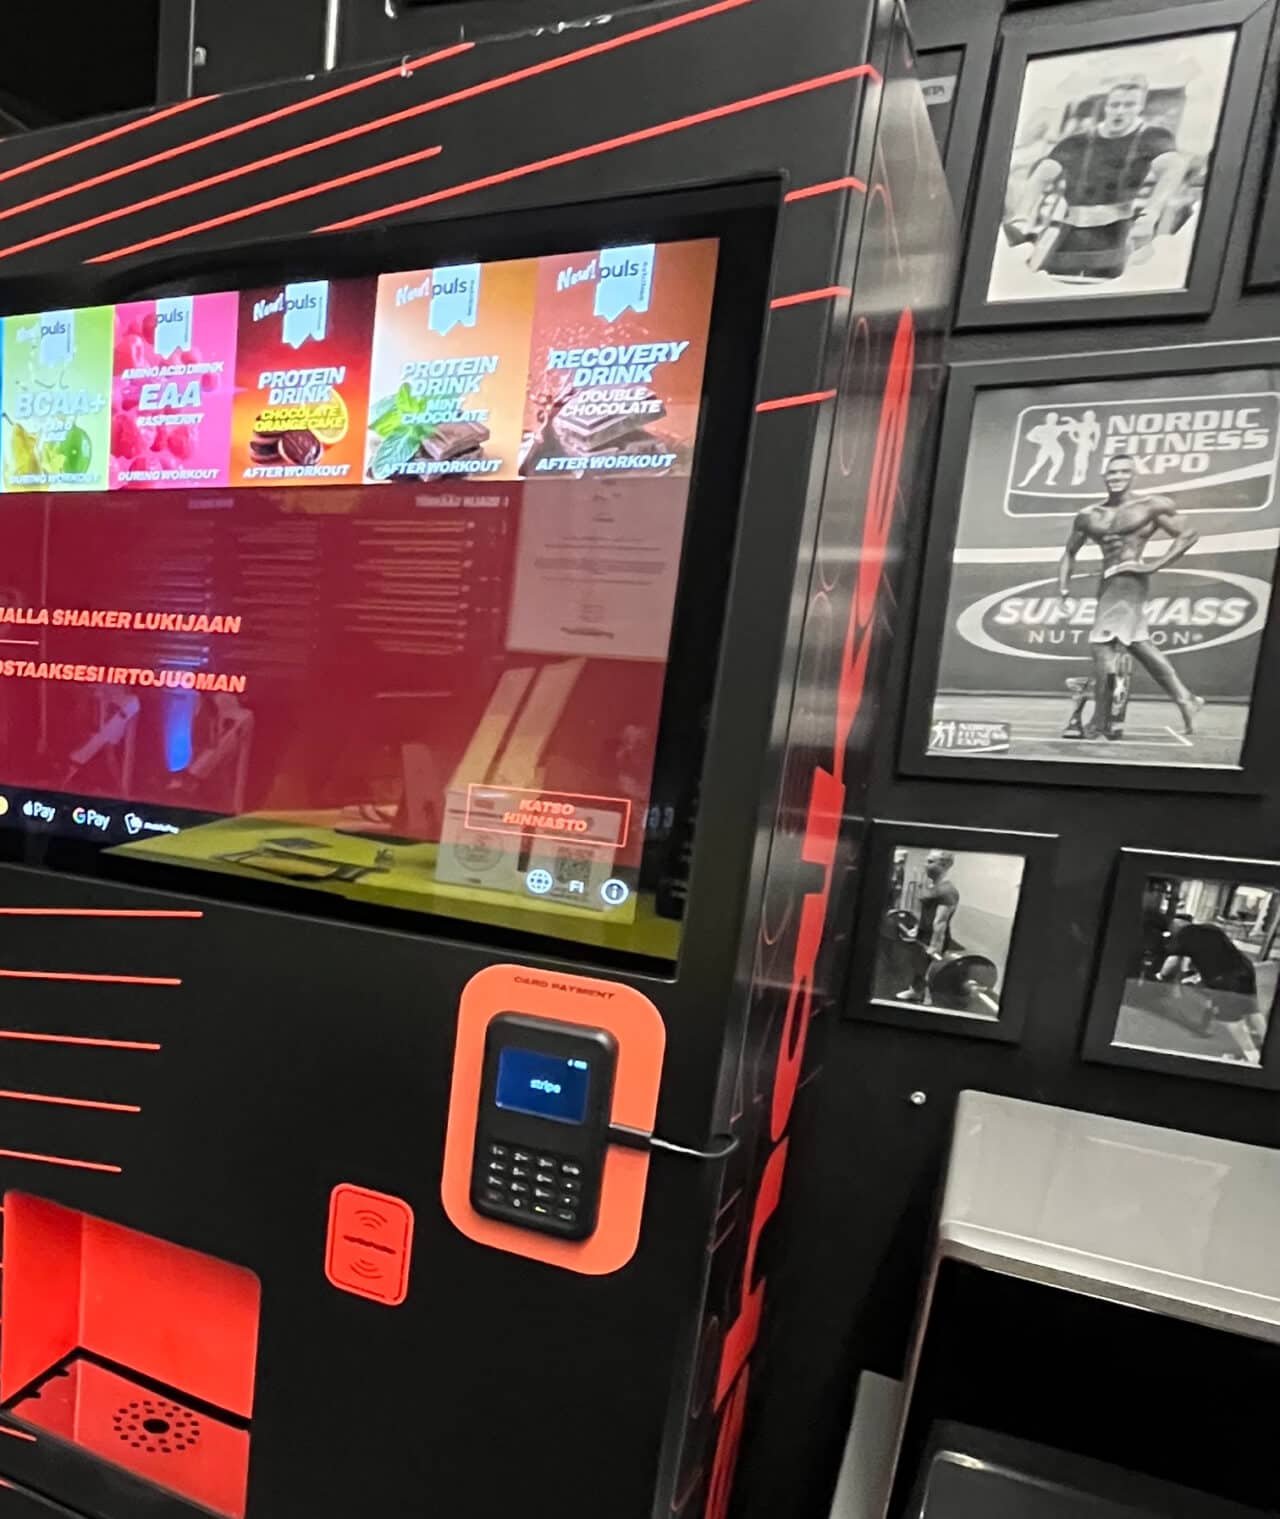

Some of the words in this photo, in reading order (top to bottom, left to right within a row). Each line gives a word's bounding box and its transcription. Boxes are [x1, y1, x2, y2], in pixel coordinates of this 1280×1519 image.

[433, 277, 467, 296] puls
[156, 308, 184, 324] puls
[545, 341, 690, 370] RECOVERY
[258, 366, 346, 390] PROTEIN
[400, 356, 499, 380] PROTEIN
[572, 364, 656, 387] DRINK
[139, 380, 201, 411] EAA
[269, 384, 333, 406] DRINK
[411, 374, 484, 398] DRINK
[578, 387, 650, 401] DOUBLE
[426, 397, 466, 412] MINT
[561, 400, 663, 416] CHOCOLATE
[401, 410, 489, 424] CHOCOLATE
[1107, 408, 1263, 435] NORDIC
[1103, 428, 1270, 455] FITNESS
[243, 466, 283, 478] AFTER
[283, 464, 351, 478] WORKOUT
[382, 462, 429, 477] AFTER
[428, 459, 503, 474] WORKOUT
[536, 457, 589, 471] AFTER
[589, 454, 677, 469] WORKOUT
[161, 468, 220, 481] WORKOUT
[52, 609, 132, 629] SHAKER
[133, 612, 242, 633] LUKIJAAN
[107, 667, 247, 693] IRTOJUOMAN
[33, 802, 56, 822] Pay
[519, 799, 575, 816] KATSO
[503, 812, 588, 833] HINNASTO
[569, 880, 584, 894] FI
[514, 976, 548, 988] CARD
[552, 984, 615, 999] PAYMENT
